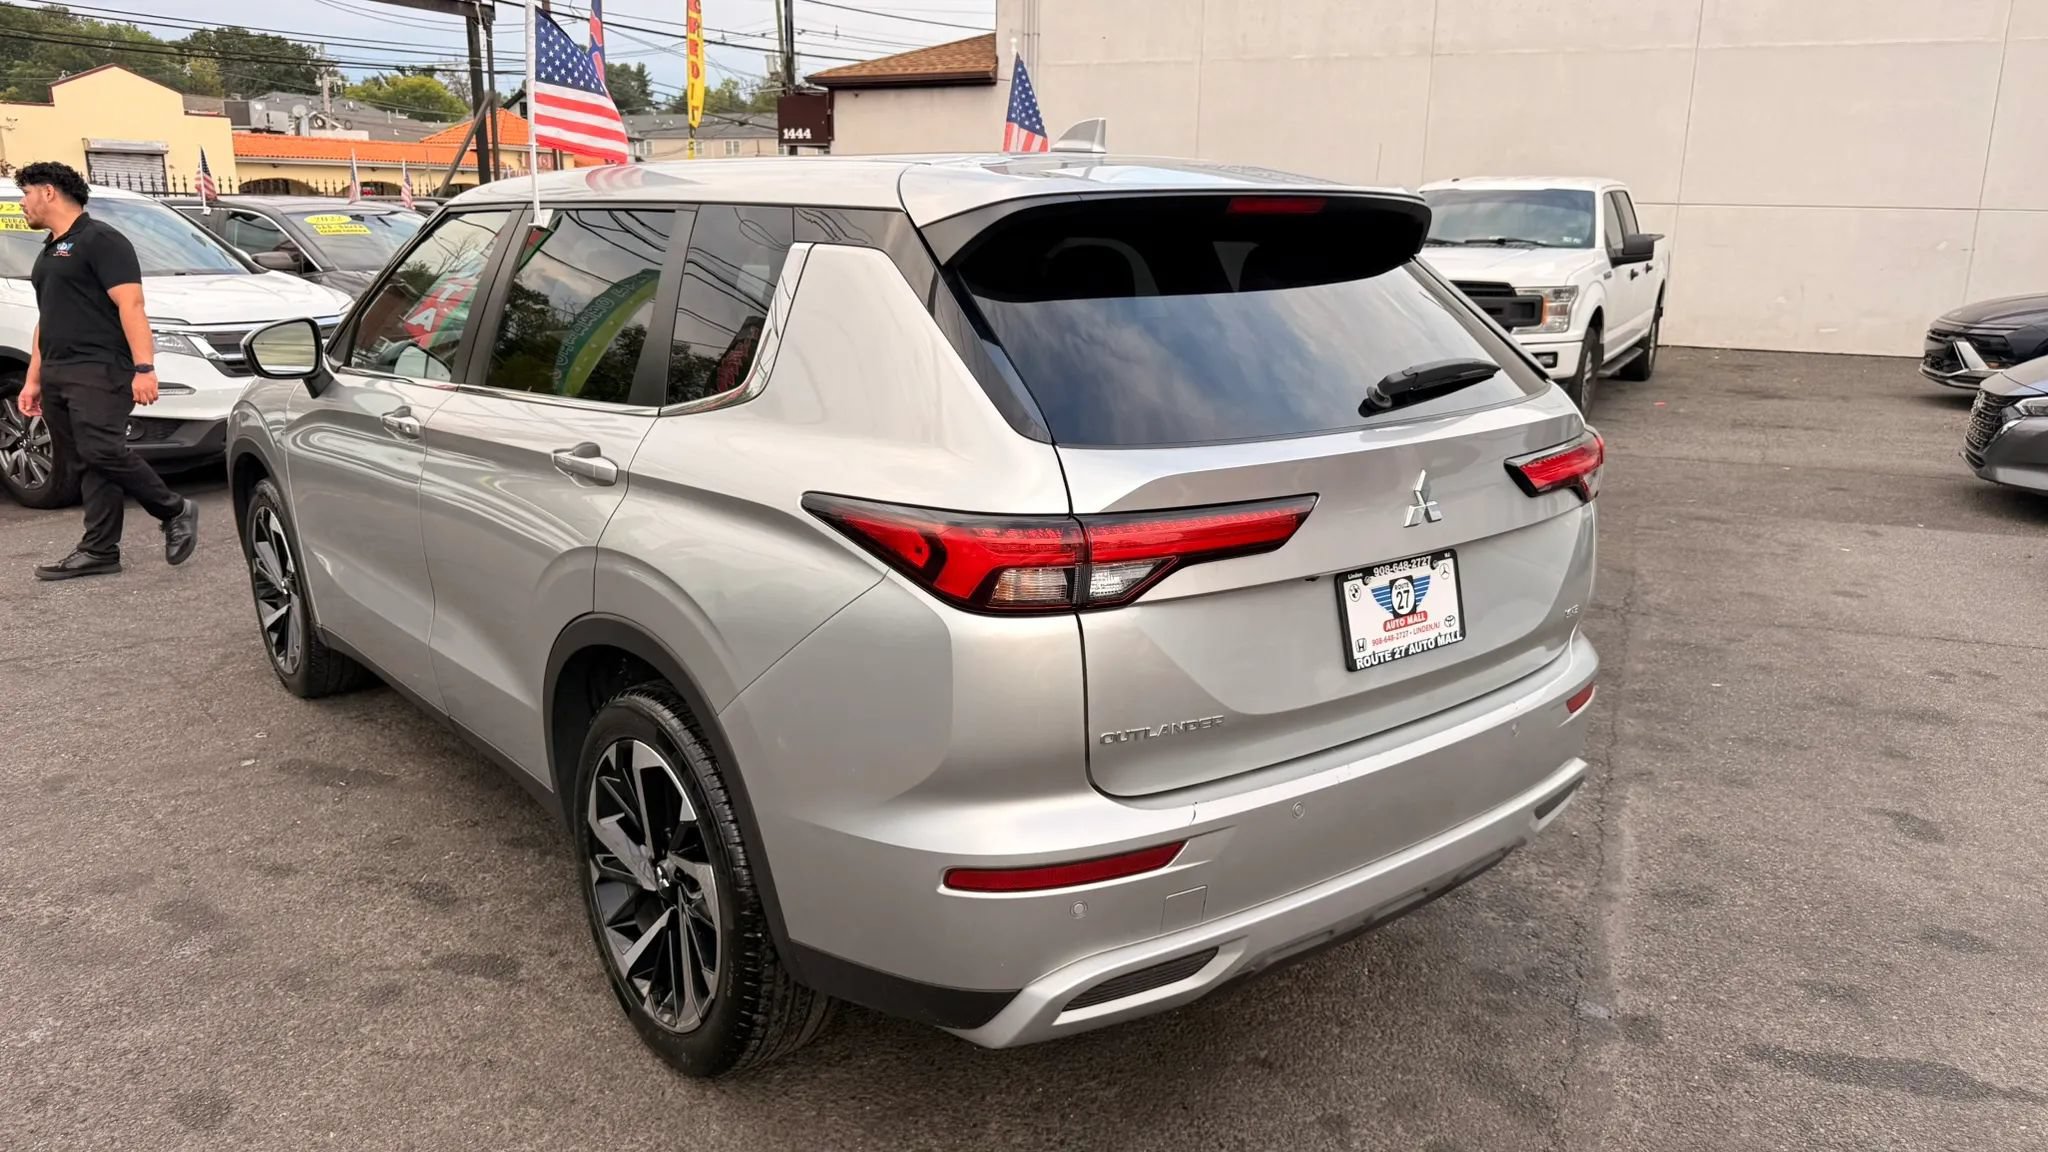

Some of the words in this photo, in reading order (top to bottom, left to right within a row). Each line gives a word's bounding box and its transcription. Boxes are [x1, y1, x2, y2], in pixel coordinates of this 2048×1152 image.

[783, 128, 812, 139] 1444
[1373, 556, 1431, 577] 908-648-2727
[1394, 582, 1410, 590] ROUTE
[1396, 589, 1410, 610] 27
[1386, 617, 1405, 630] AUTO
[1406, 612, 1425, 625] MALL
[1356, 651, 1392, 669] ROUTE
[1393, 648, 1406, 659] 27
[1408, 639, 1435, 655] AUTO
[1437, 630, 1463, 647] MALL
[1100, 715, 1224, 744] OUTLANDER
